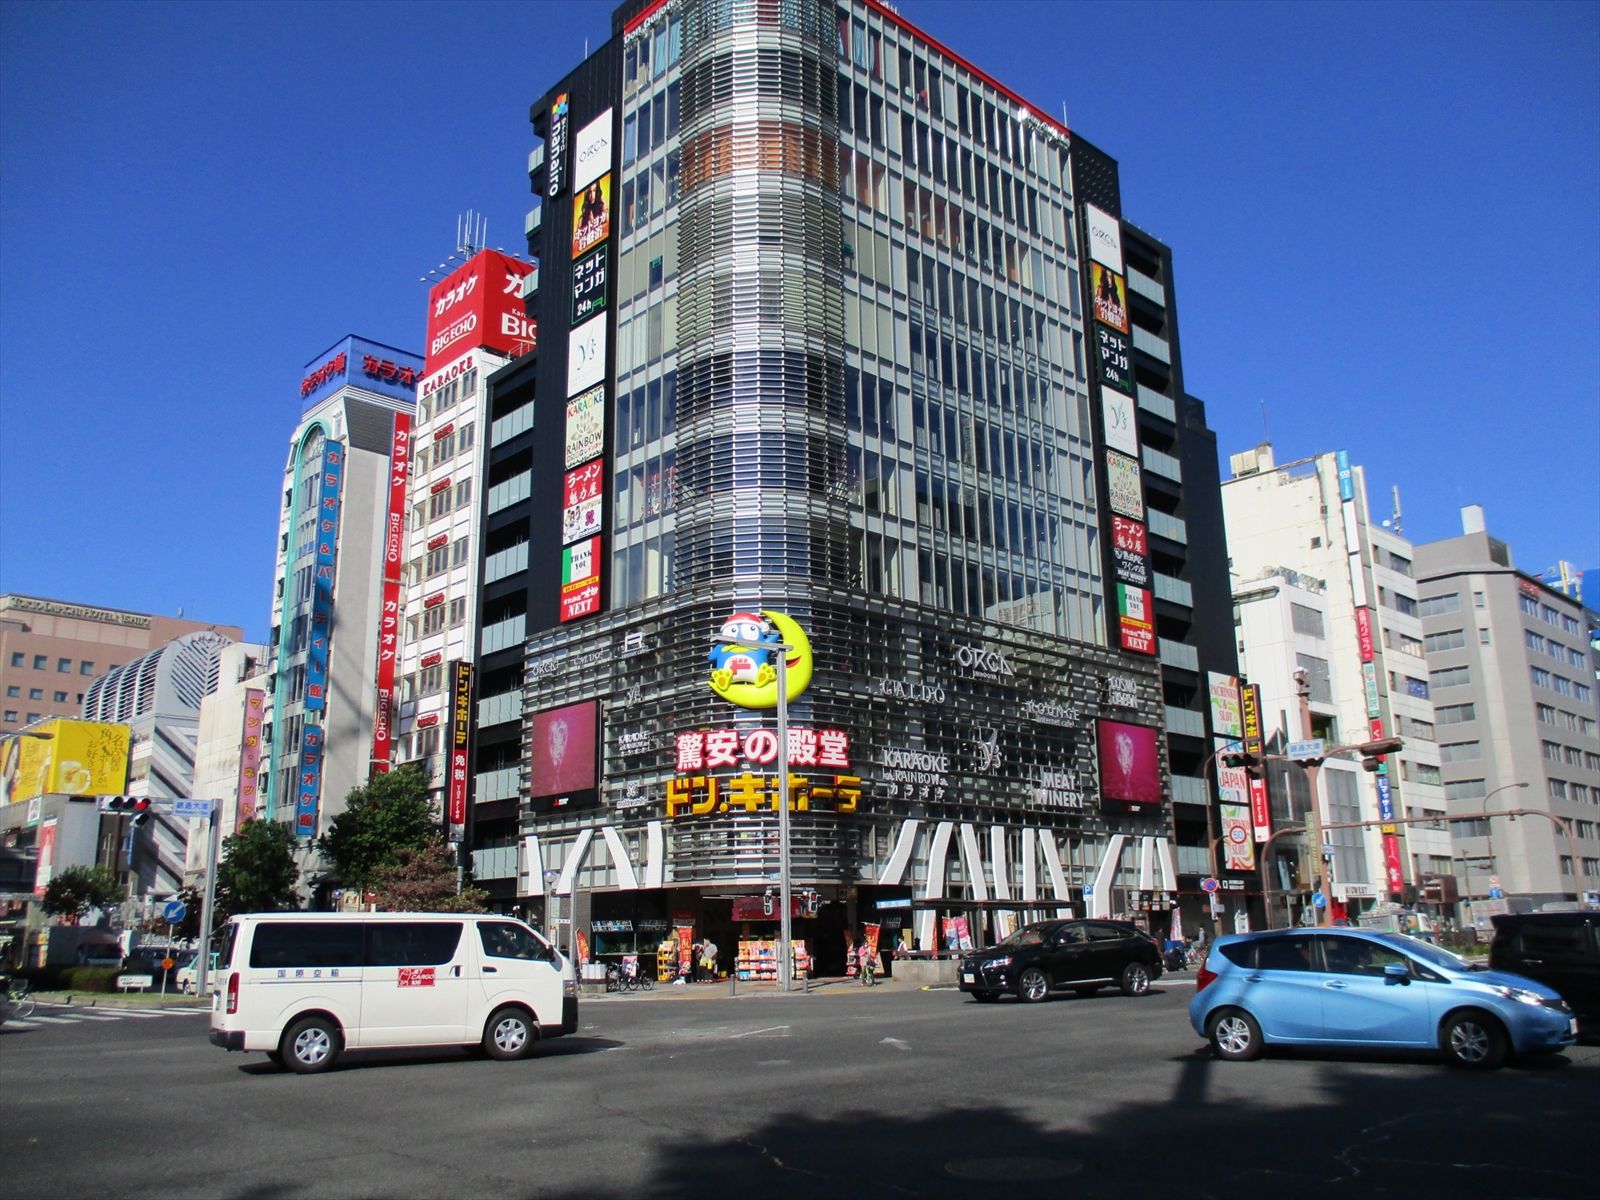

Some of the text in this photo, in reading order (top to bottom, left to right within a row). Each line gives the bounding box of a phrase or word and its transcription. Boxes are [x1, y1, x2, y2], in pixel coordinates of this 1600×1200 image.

[549, 122, 562, 197] nanairo
[574, 253, 604, 280] ネット
[574, 267, 604, 299] マンガ
[435, 275, 478, 318] カラオケ
[577, 299, 592, 316] 24h
[432, 331, 450, 356] BIG
[450, 314, 477, 340] ECHO
[1100, 330, 1126, 352] ネット
[1101, 346, 1128, 370] マンガ
[423, 355, 473, 396] KARAOKE
[1105, 367, 1120, 382] 24h
[567, 391, 604, 418] KARAOKE
[566, 430, 602, 455] RAINBOW
[391, 431, 408, 487] カラオケ
[567, 464, 601, 489] ラーメン
[1114, 518, 1143, 537] ラーメン
[568, 598, 592, 617] NEXT
[381, 600, 397, 661] カラオケ
[1127, 637, 1148, 651] NEXT
[676, 728, 849, 772] 驚安の殿堂
[882, 749, 949, 774] KARAOKE
[455, 754, 465, 780] 免税
[895, 769, 940, 785] RAINBOW
[299, 732, 318, 828] カラオケ館
[889, 783, 945, 799] カラオケ
[1043, 771, 1076, 790] MEAT
[1219, 771, 1245, 790] JAPAN
[666, 772, 861, 817] ドン・キホーテ
[1034, 788, 1085, 808] WINERY
[277, 969, 339, 979] 国際空輸
